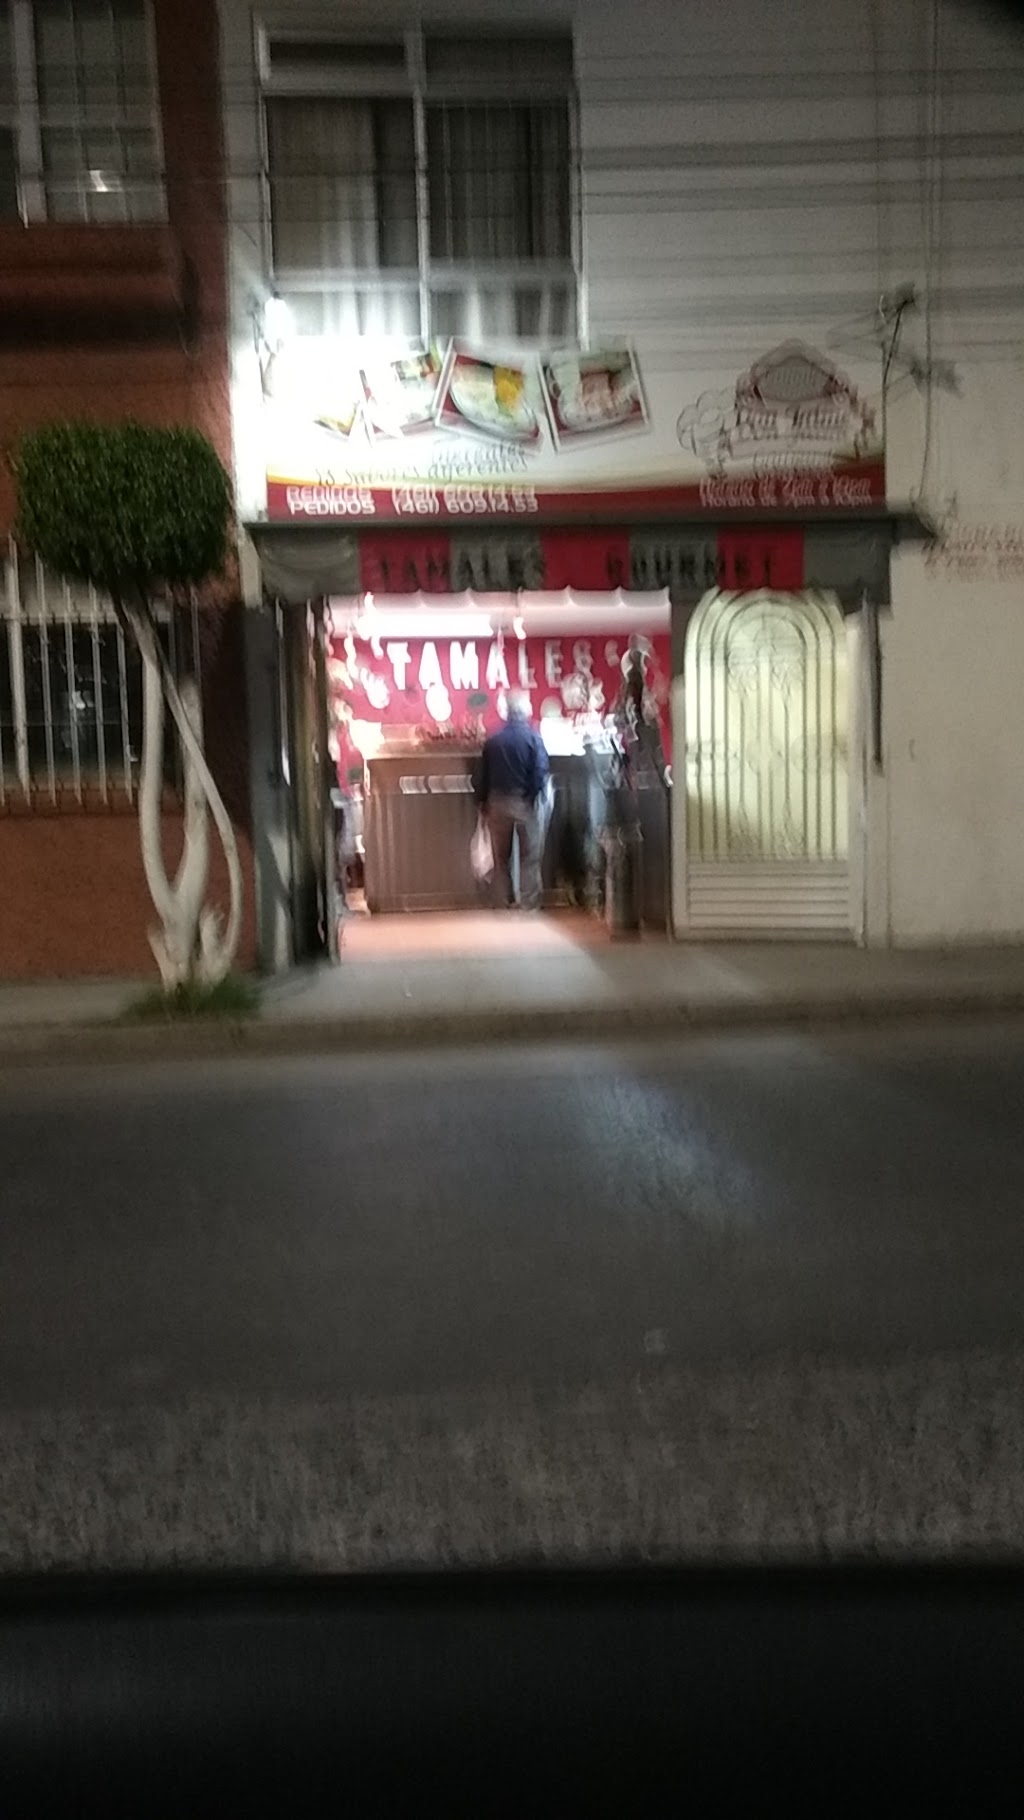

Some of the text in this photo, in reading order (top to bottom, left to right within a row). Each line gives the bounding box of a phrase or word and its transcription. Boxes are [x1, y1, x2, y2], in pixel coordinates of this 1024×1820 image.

[287, 491, 376, 515] PEDIDOS
[394, 490, 439, 515] (461)
[387, 640, 594, 690] TAMALES
